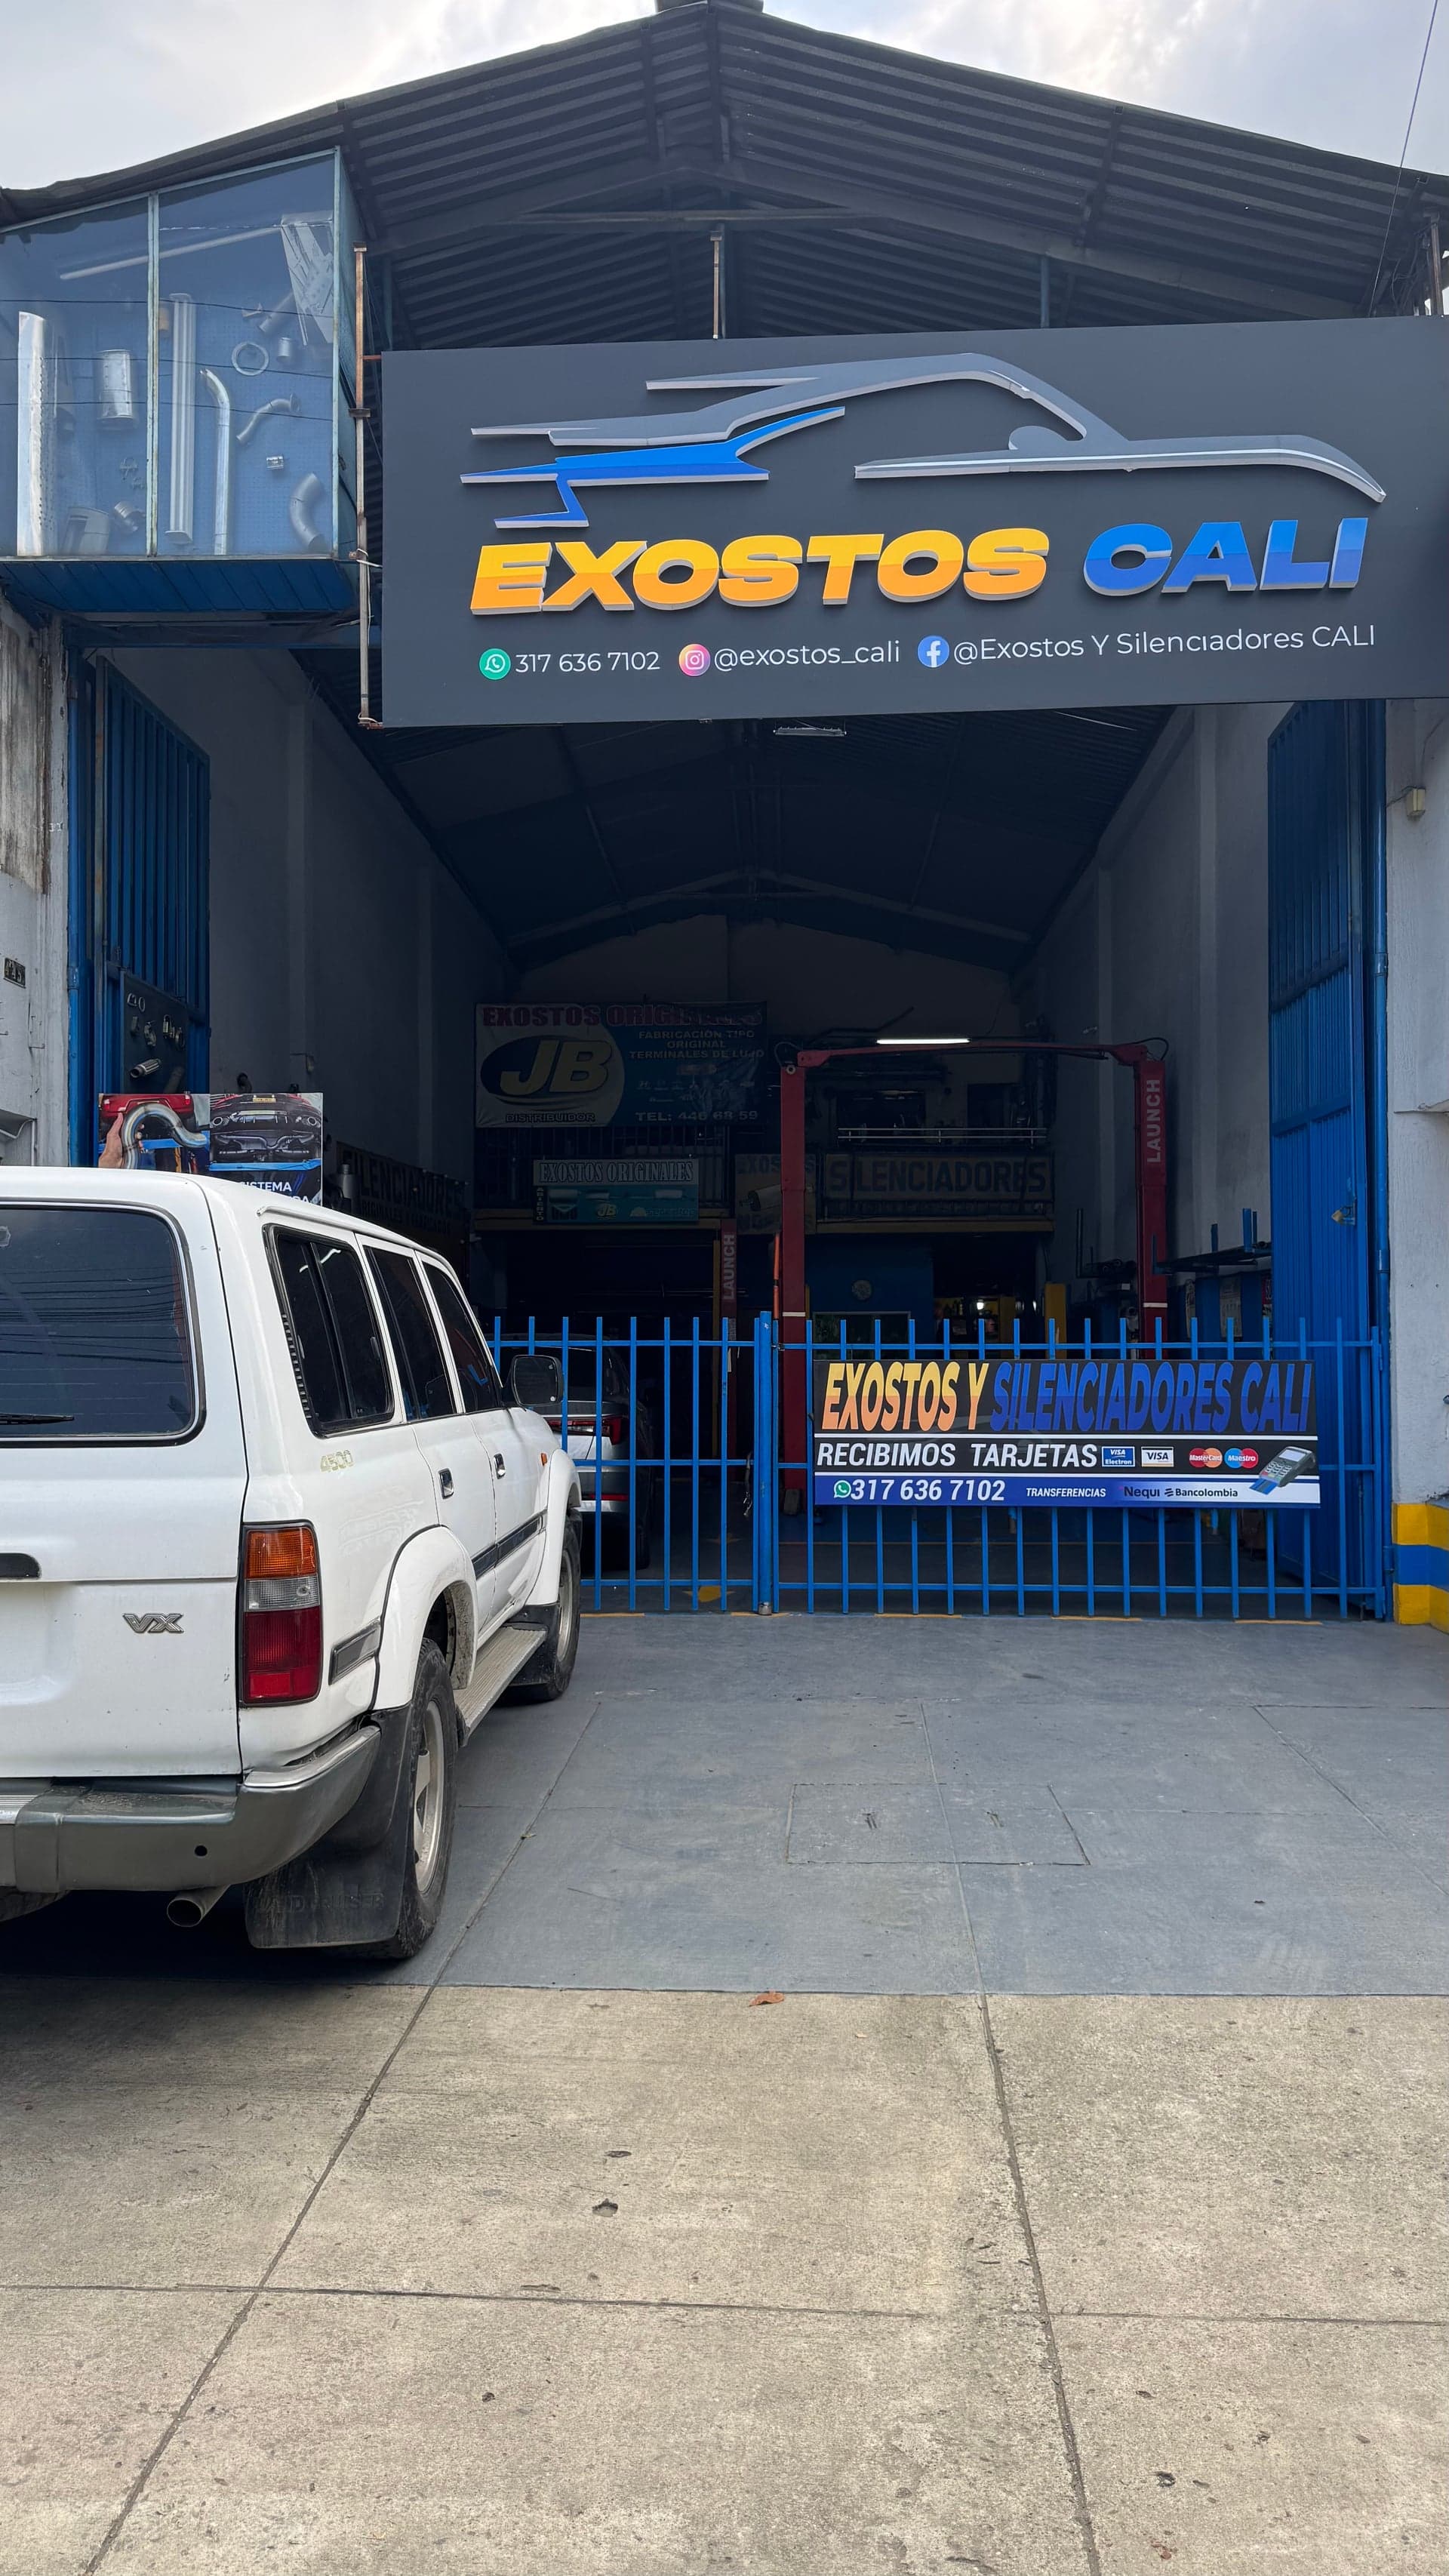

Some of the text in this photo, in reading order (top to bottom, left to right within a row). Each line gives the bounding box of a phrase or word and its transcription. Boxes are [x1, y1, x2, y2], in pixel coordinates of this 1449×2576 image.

[471, 518, 1368, 615] EXOSTOS CALI
[714, 640, 900, 671] @exostos_cali
[954, 625, 1376, 666] @Exostos Y Silenciadores CALI
[515, 651, 660, 672] 317 636 7102
[482, 1006, 600, 1027] EXOSTOS
[629, 1050, 710, 1059] TERMINALES
[667, 1041, 726, 1049] ORIGINAL
[500, 1039, 612, 1096] JB
[506, 1113, 595, 1123] DISTRIBUIDOR
[635, 1112, 672, 1122] TEL:
[1146, 1079, 1161, 1163] LAUNCH
[607, 1161, 693, 1183] ORIGINALES
[723, 1234, 736, 1300] LAUNCH
[820, 1361, 1313, 1433] EXOSTOS Y SILENCIADORES CALI
[817, 1442, 1098, 1468] RECIBIMOS TARJETAS
[1109, 1448, 1126, 1457] VISA
[1146, 1451, 1169, 1461] VISA
[1189, 1454, 1223, 1462] MasterCard
[1228, 1454, 1256, 1463] Maestro
[851, 1479, 1005, 1501] 317 636 7102
[1026, 1488, 1106, 1497] TRANSFERENCIAS
[1123, 1486, 1160, 1499] Nequi
[1175, 1488, 1238, 1497] Bancolombia
[122, 1613, 185, 1633] VX
